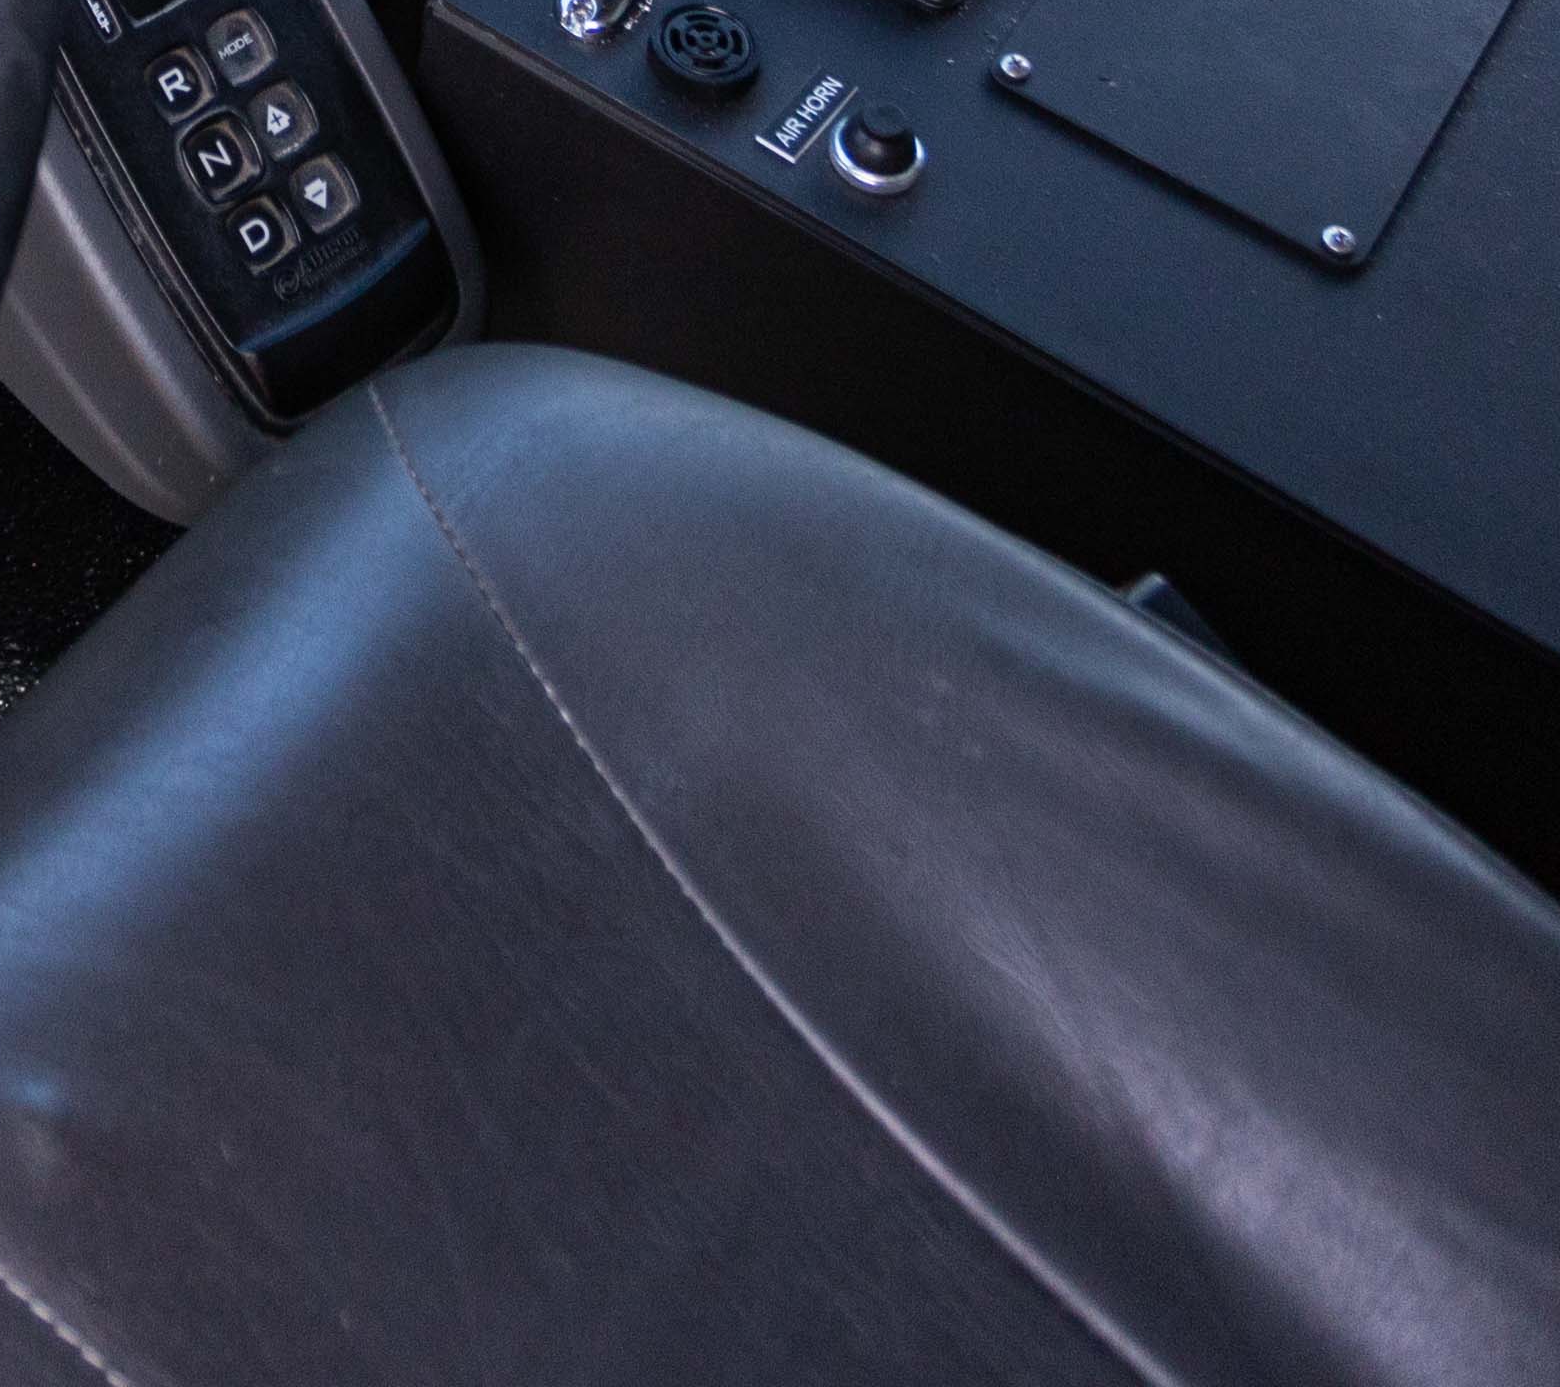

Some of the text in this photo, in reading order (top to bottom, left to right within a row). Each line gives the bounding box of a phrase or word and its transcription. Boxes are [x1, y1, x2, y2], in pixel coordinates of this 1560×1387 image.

[218, 30, 255, 61] MODE
[157, 67, 192, 103] R
[775, 76, 844, 149] AIR HORN
[198, 140, 232, 178] N
[239, 218, 270, 254] D
